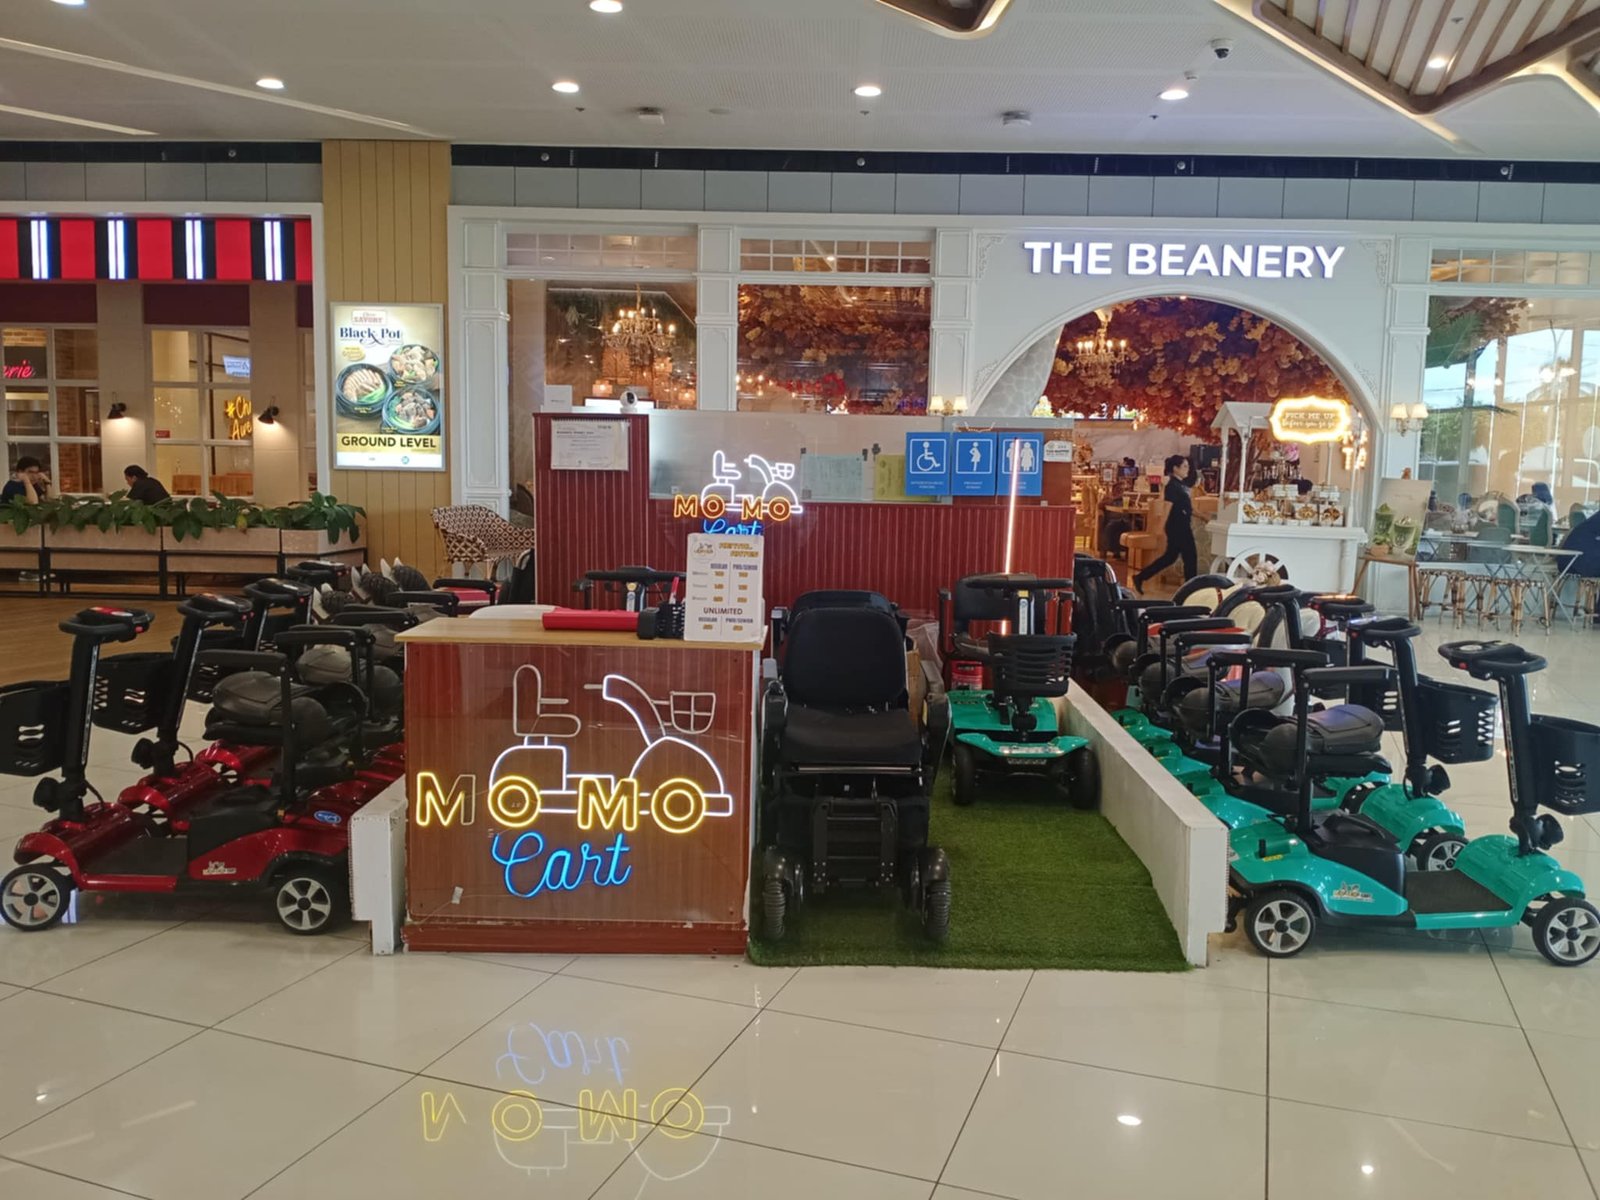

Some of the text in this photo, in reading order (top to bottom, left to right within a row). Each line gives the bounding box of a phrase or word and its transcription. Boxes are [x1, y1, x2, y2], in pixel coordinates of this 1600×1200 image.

[1023, 241, 1347, 280] THE BEANERY
[339, 327, 401, 345] Black Pot
[1307, 412, 1321, 420] ME
[341, 436, 437, 448] GROUND LEVEL
[703, 607, 743, 615] UNLIMITED
[491, 831, 632, 898] Cart
